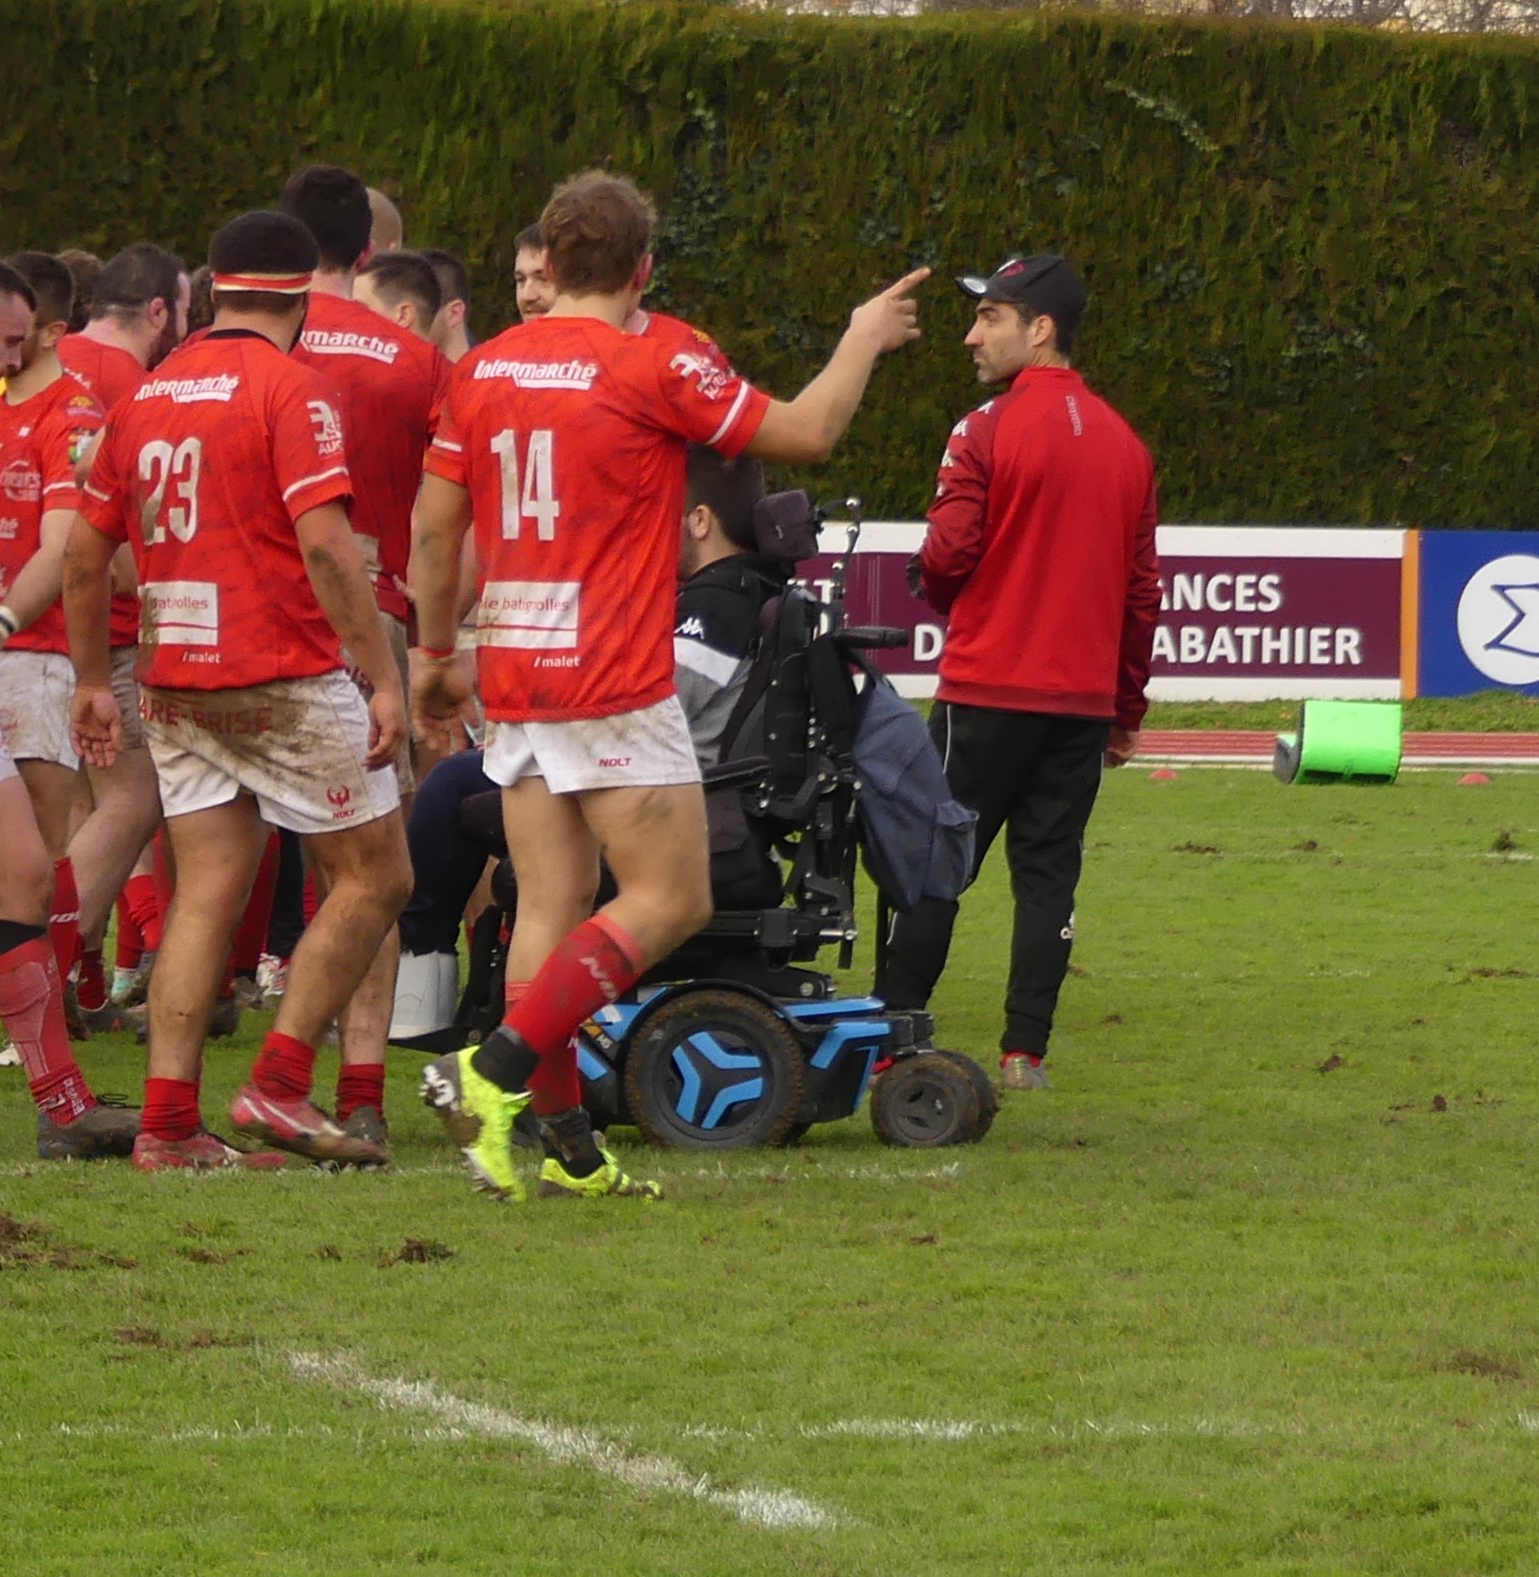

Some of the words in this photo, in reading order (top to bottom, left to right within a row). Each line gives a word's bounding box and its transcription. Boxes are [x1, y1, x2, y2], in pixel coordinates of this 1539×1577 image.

[137, 436, 201, 546] 23
[490, 429, 560, 541] 14
[1151, 626, 1362, 665] ABATHIER
